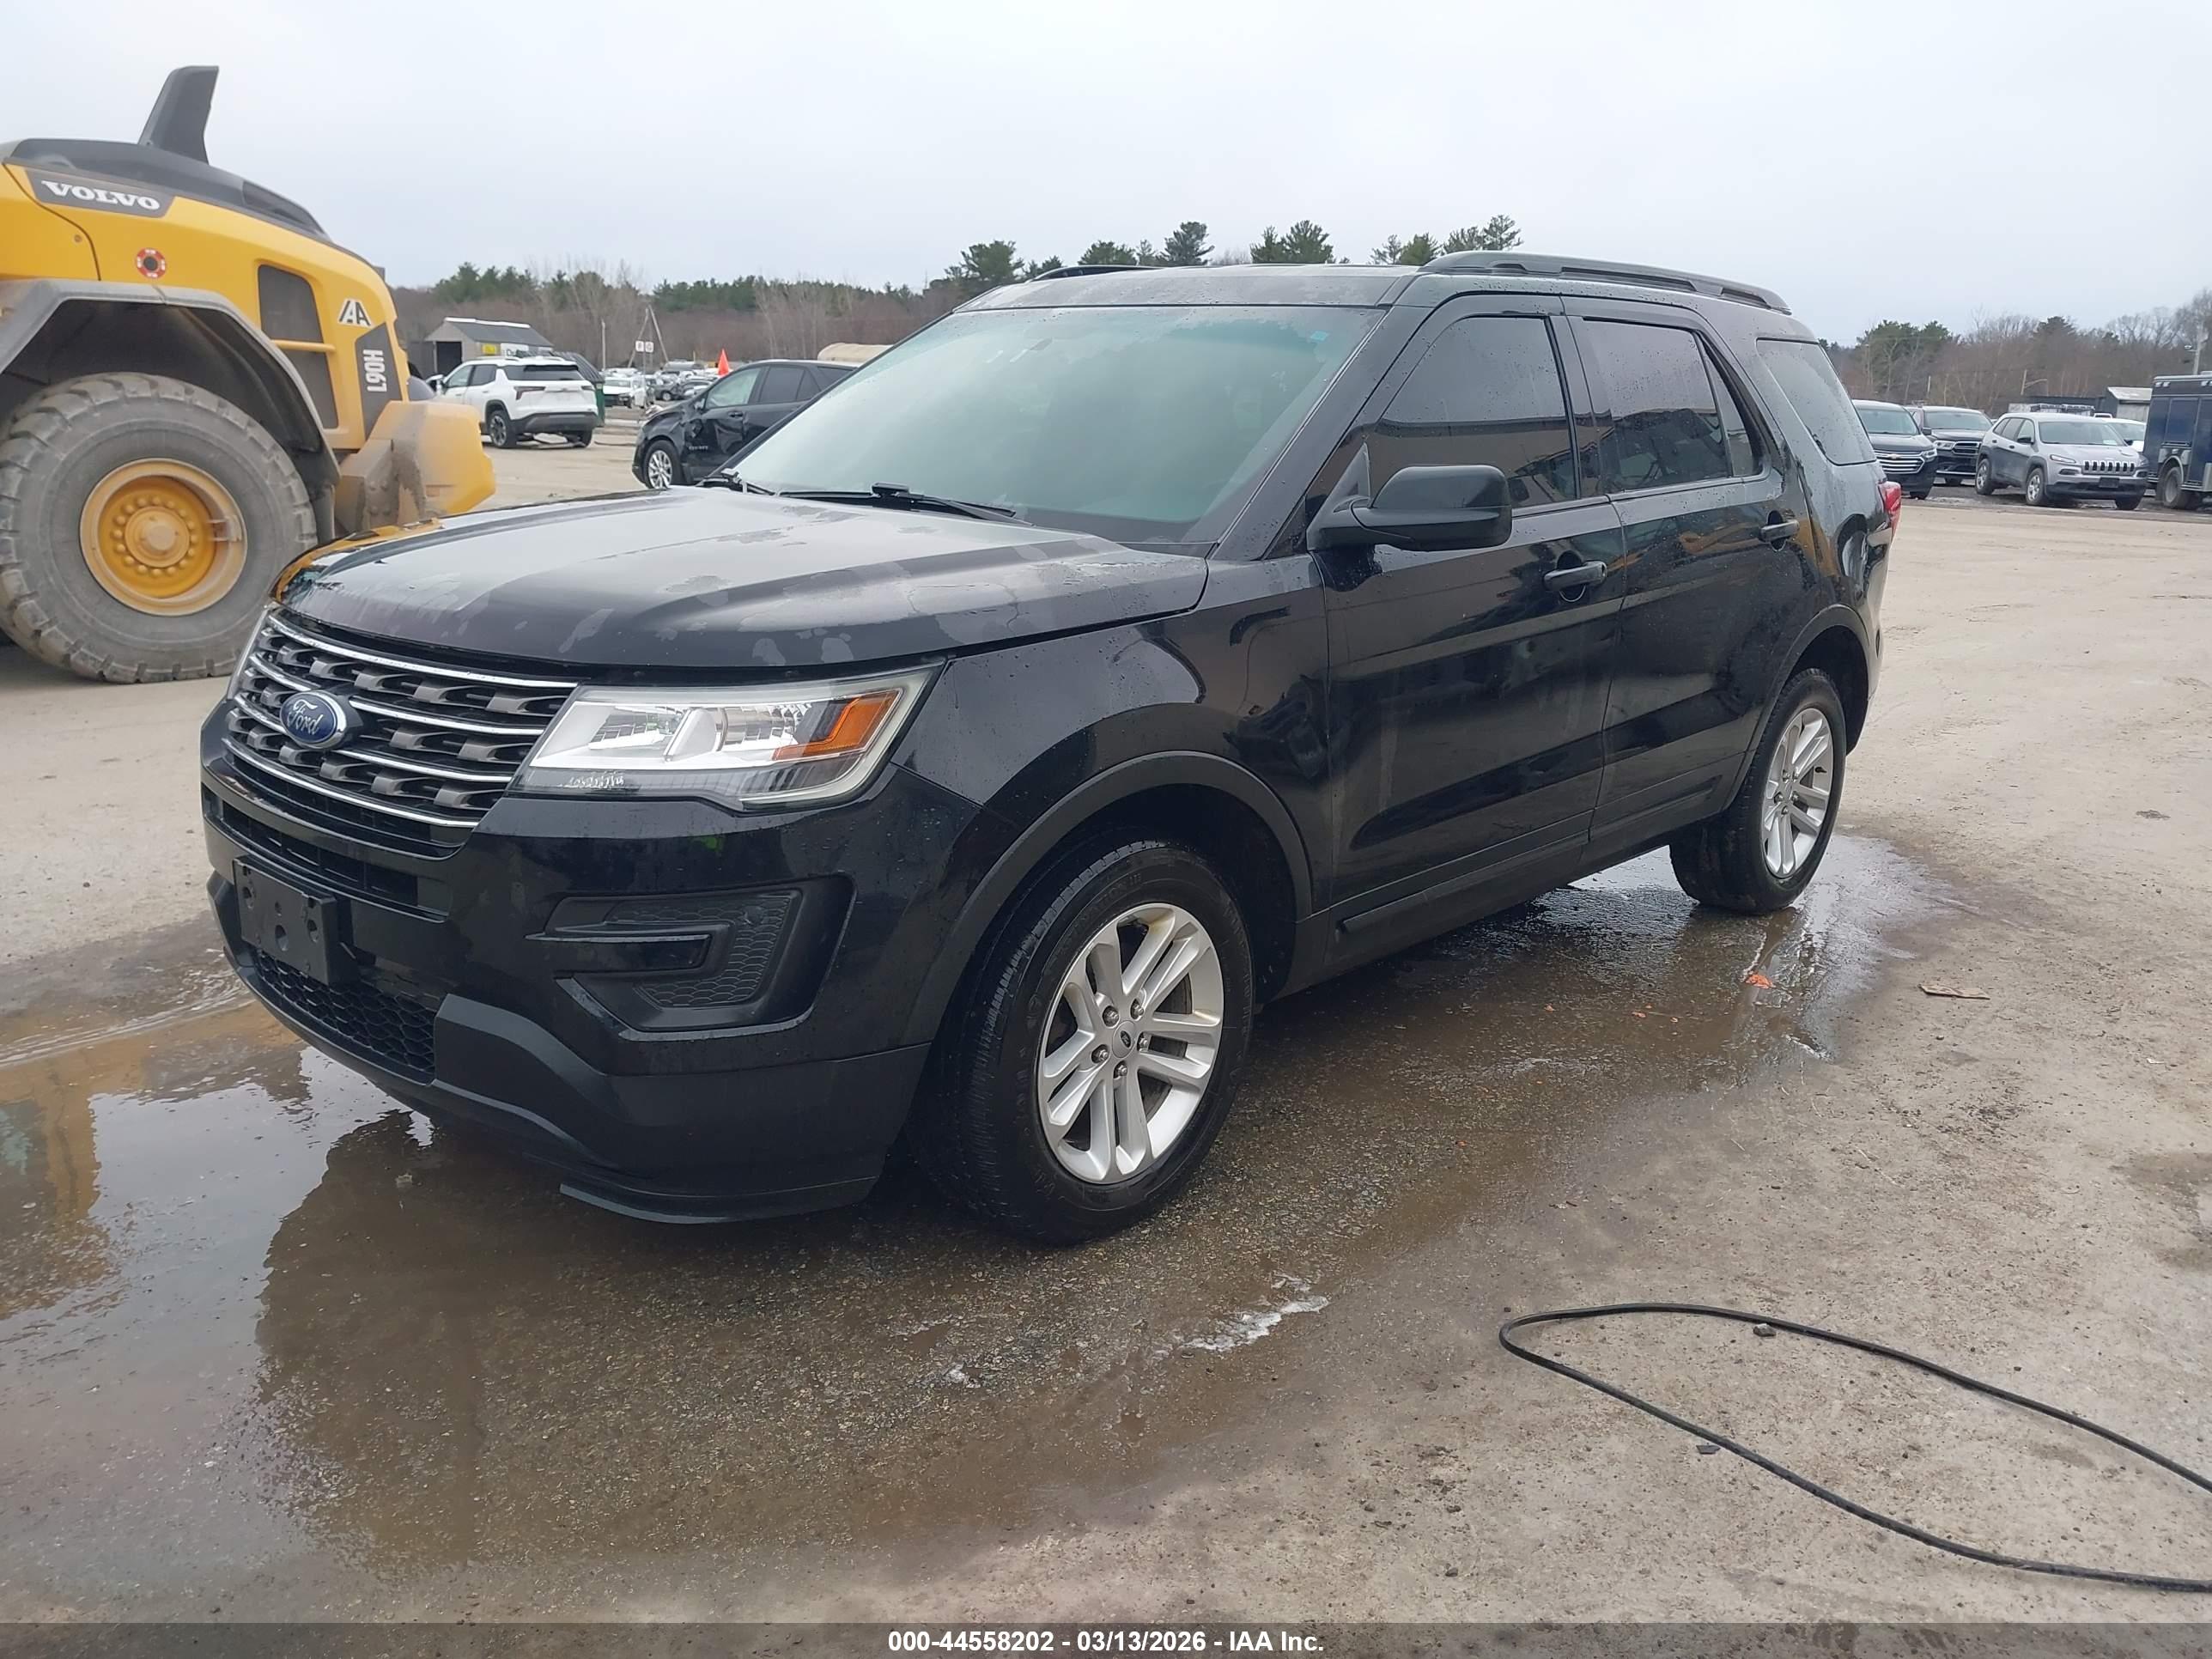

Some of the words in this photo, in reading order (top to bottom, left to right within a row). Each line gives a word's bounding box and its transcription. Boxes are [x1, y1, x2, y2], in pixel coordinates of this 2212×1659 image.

[41, 179, 161, 211] VOLVO
[362, 348, 388, 392] L90H
[287, 698, 324, 736] Ford
